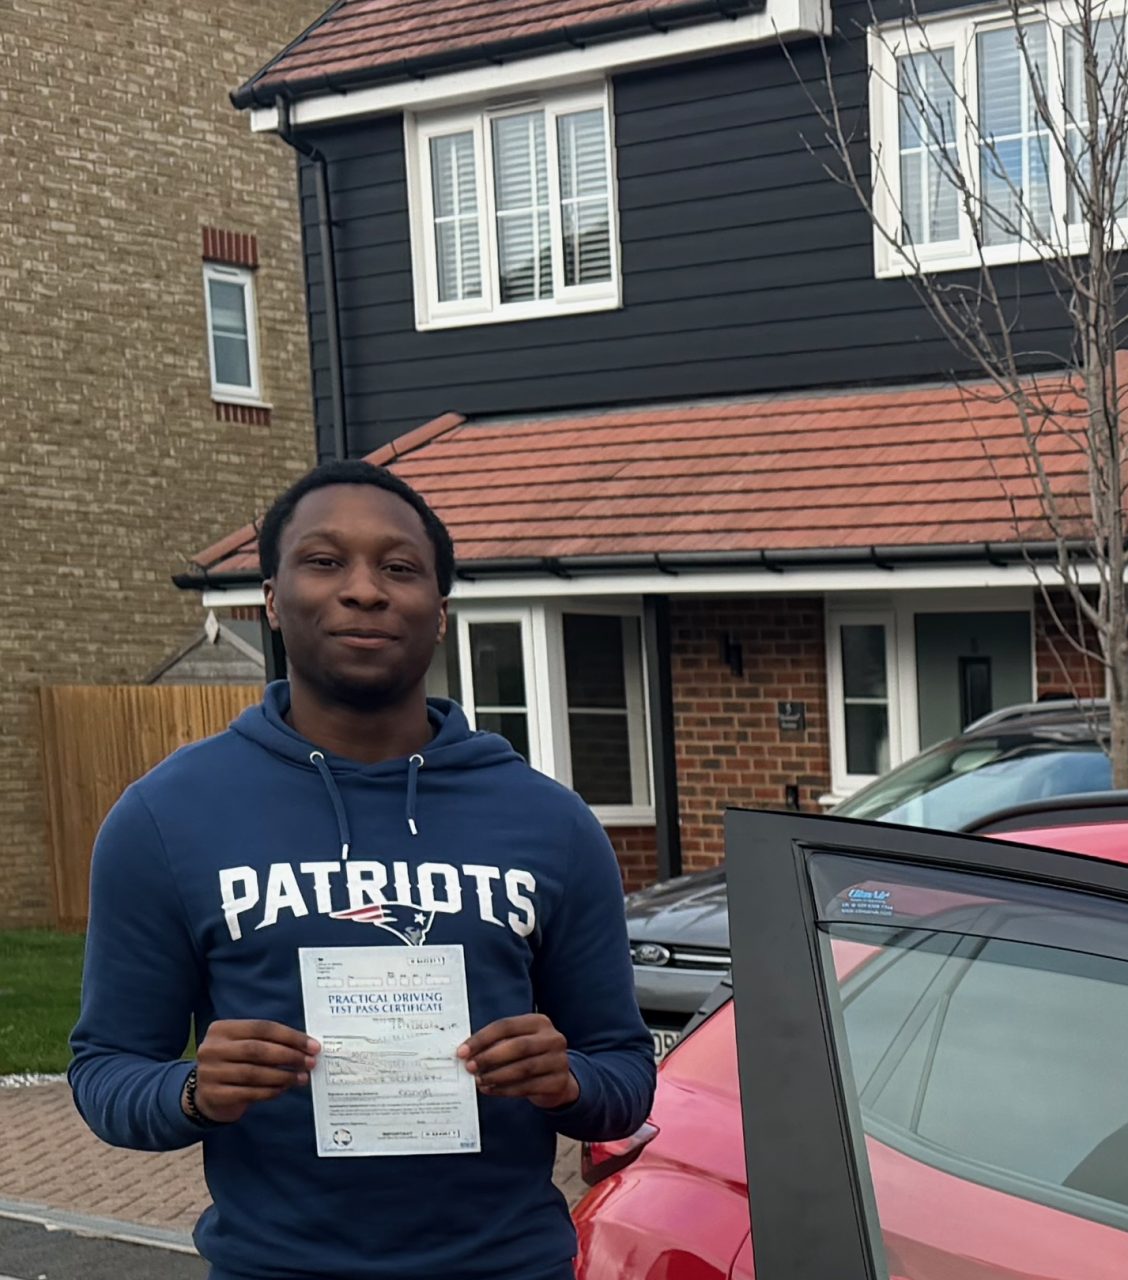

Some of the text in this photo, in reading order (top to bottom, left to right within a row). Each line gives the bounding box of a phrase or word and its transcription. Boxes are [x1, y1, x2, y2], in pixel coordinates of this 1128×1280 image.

[219, 861, 536, 941] PATRIOTS
[328, 992, 443, 1005] PRACTICAL DRIVING
[329, 1002, 442, 1015] TEST PASS CERTIFICATE
